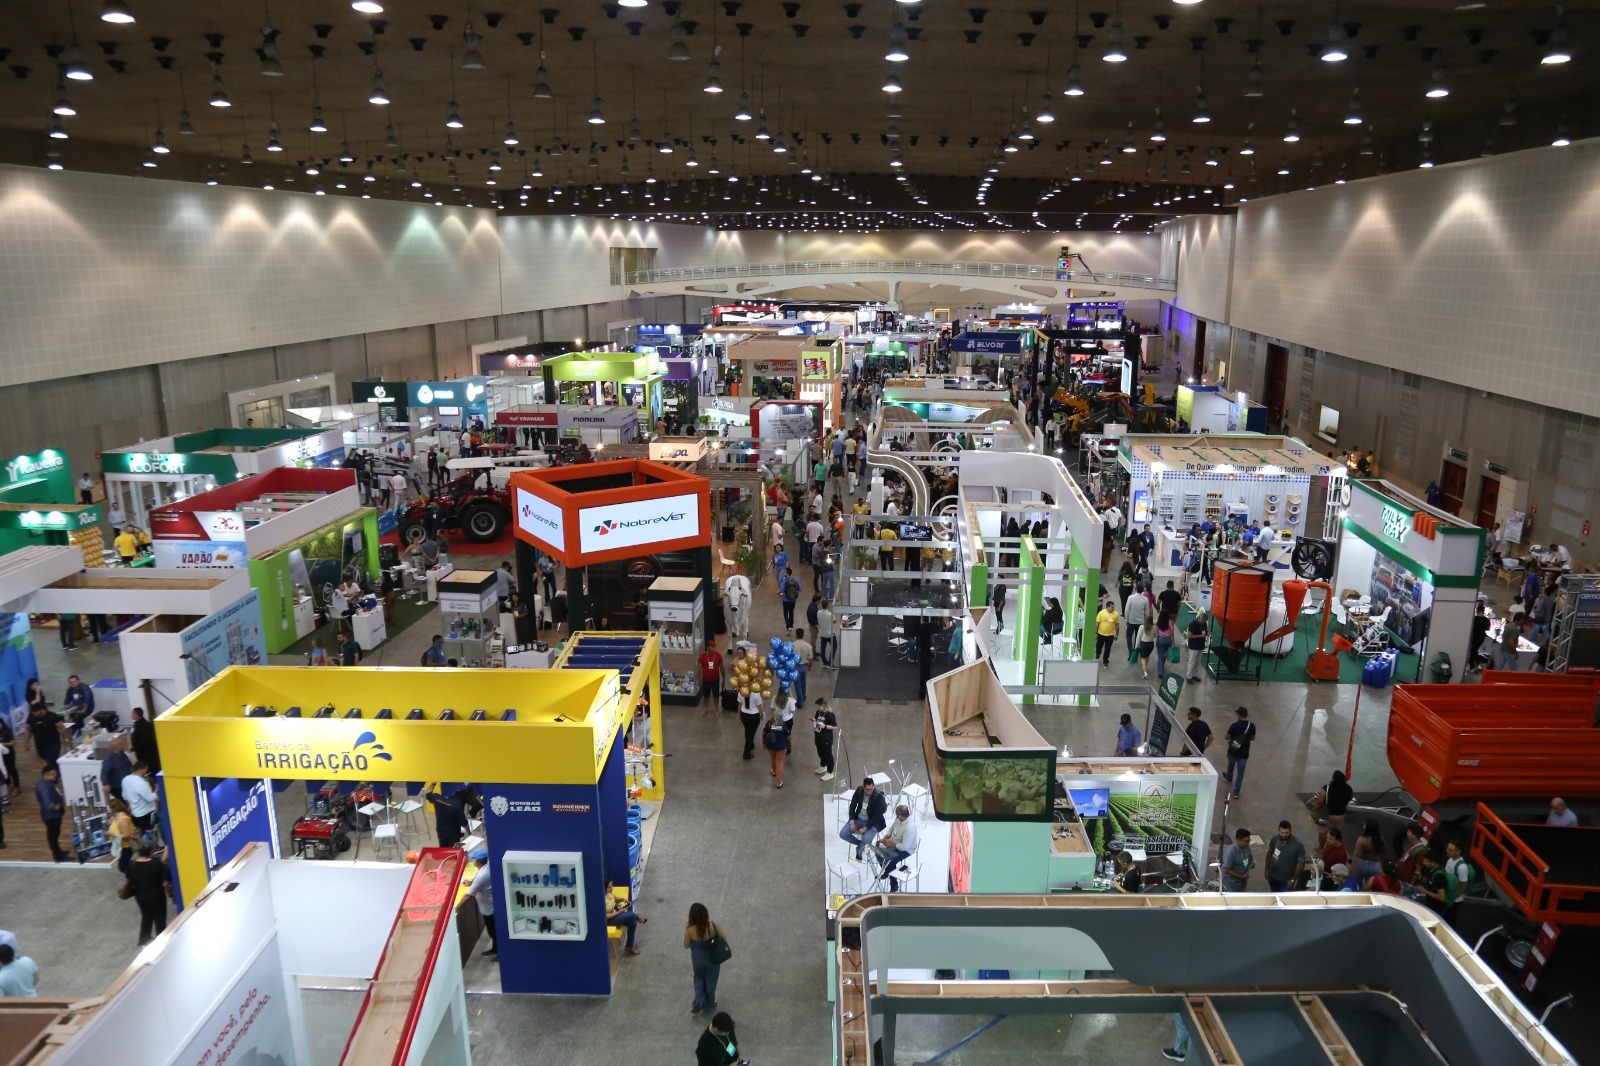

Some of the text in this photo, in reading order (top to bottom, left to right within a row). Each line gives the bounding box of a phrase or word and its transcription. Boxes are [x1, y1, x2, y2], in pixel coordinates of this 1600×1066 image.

[129, 462, 187, 474] ICOFORT
[1186, 462, 1195, 471] De
[1245, 465, 1257, 473] pro
[619, 511, 687, 529] NobreVET
[181, 551, 213, 564] RAÇÃO
[257, 750, 368, 773] IRRIGAÇÃO
[211, 795, 258, 849] IRRIGAÇÃO
[212, 1014, 238, 1049] você,
[239, 988, 257, 1018] pelo
[215, 994, 271, 1066] desempenho.
